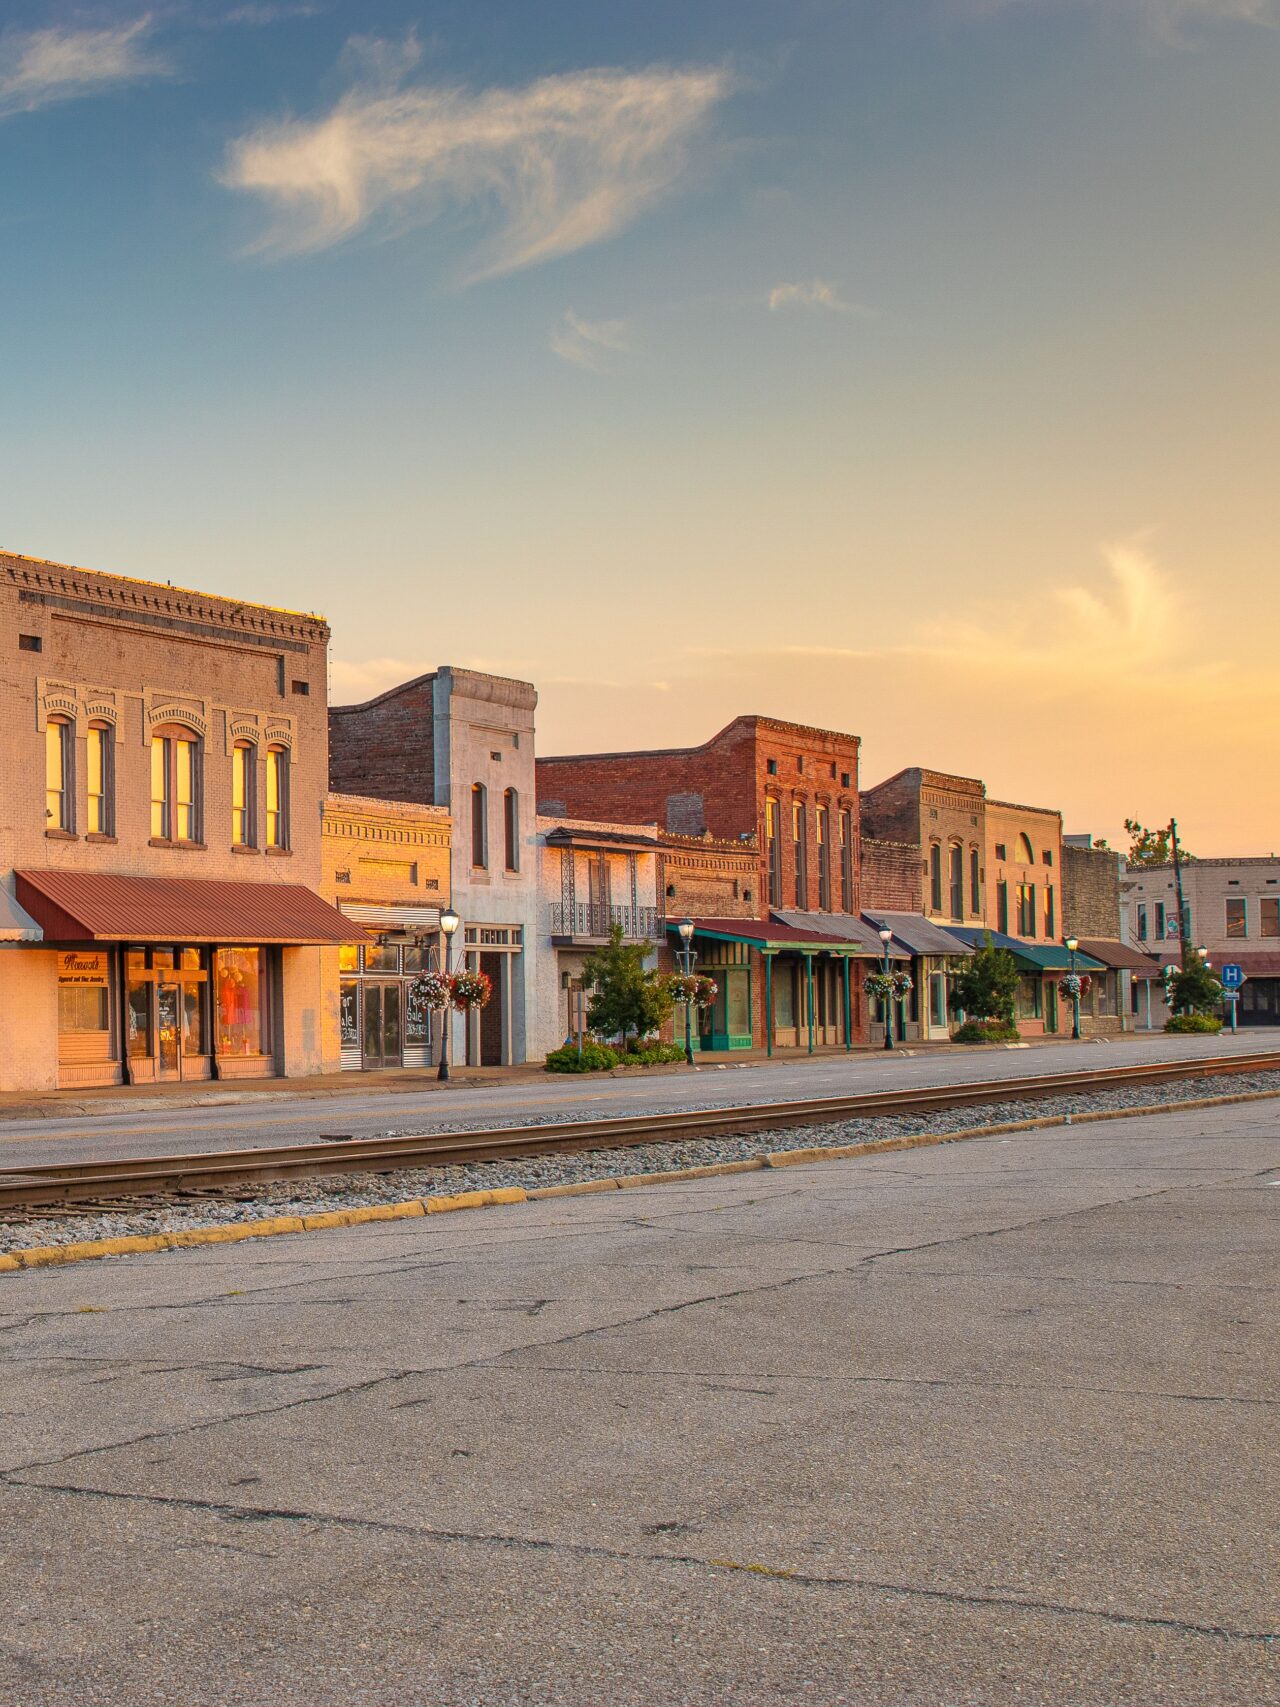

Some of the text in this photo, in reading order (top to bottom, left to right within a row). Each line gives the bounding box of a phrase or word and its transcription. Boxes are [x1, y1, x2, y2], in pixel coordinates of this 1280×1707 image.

[1226, 968, 1238, 981] H
[341, 1007, 353, 1027] ale
[406, 1007, 422, 1023] Sale
